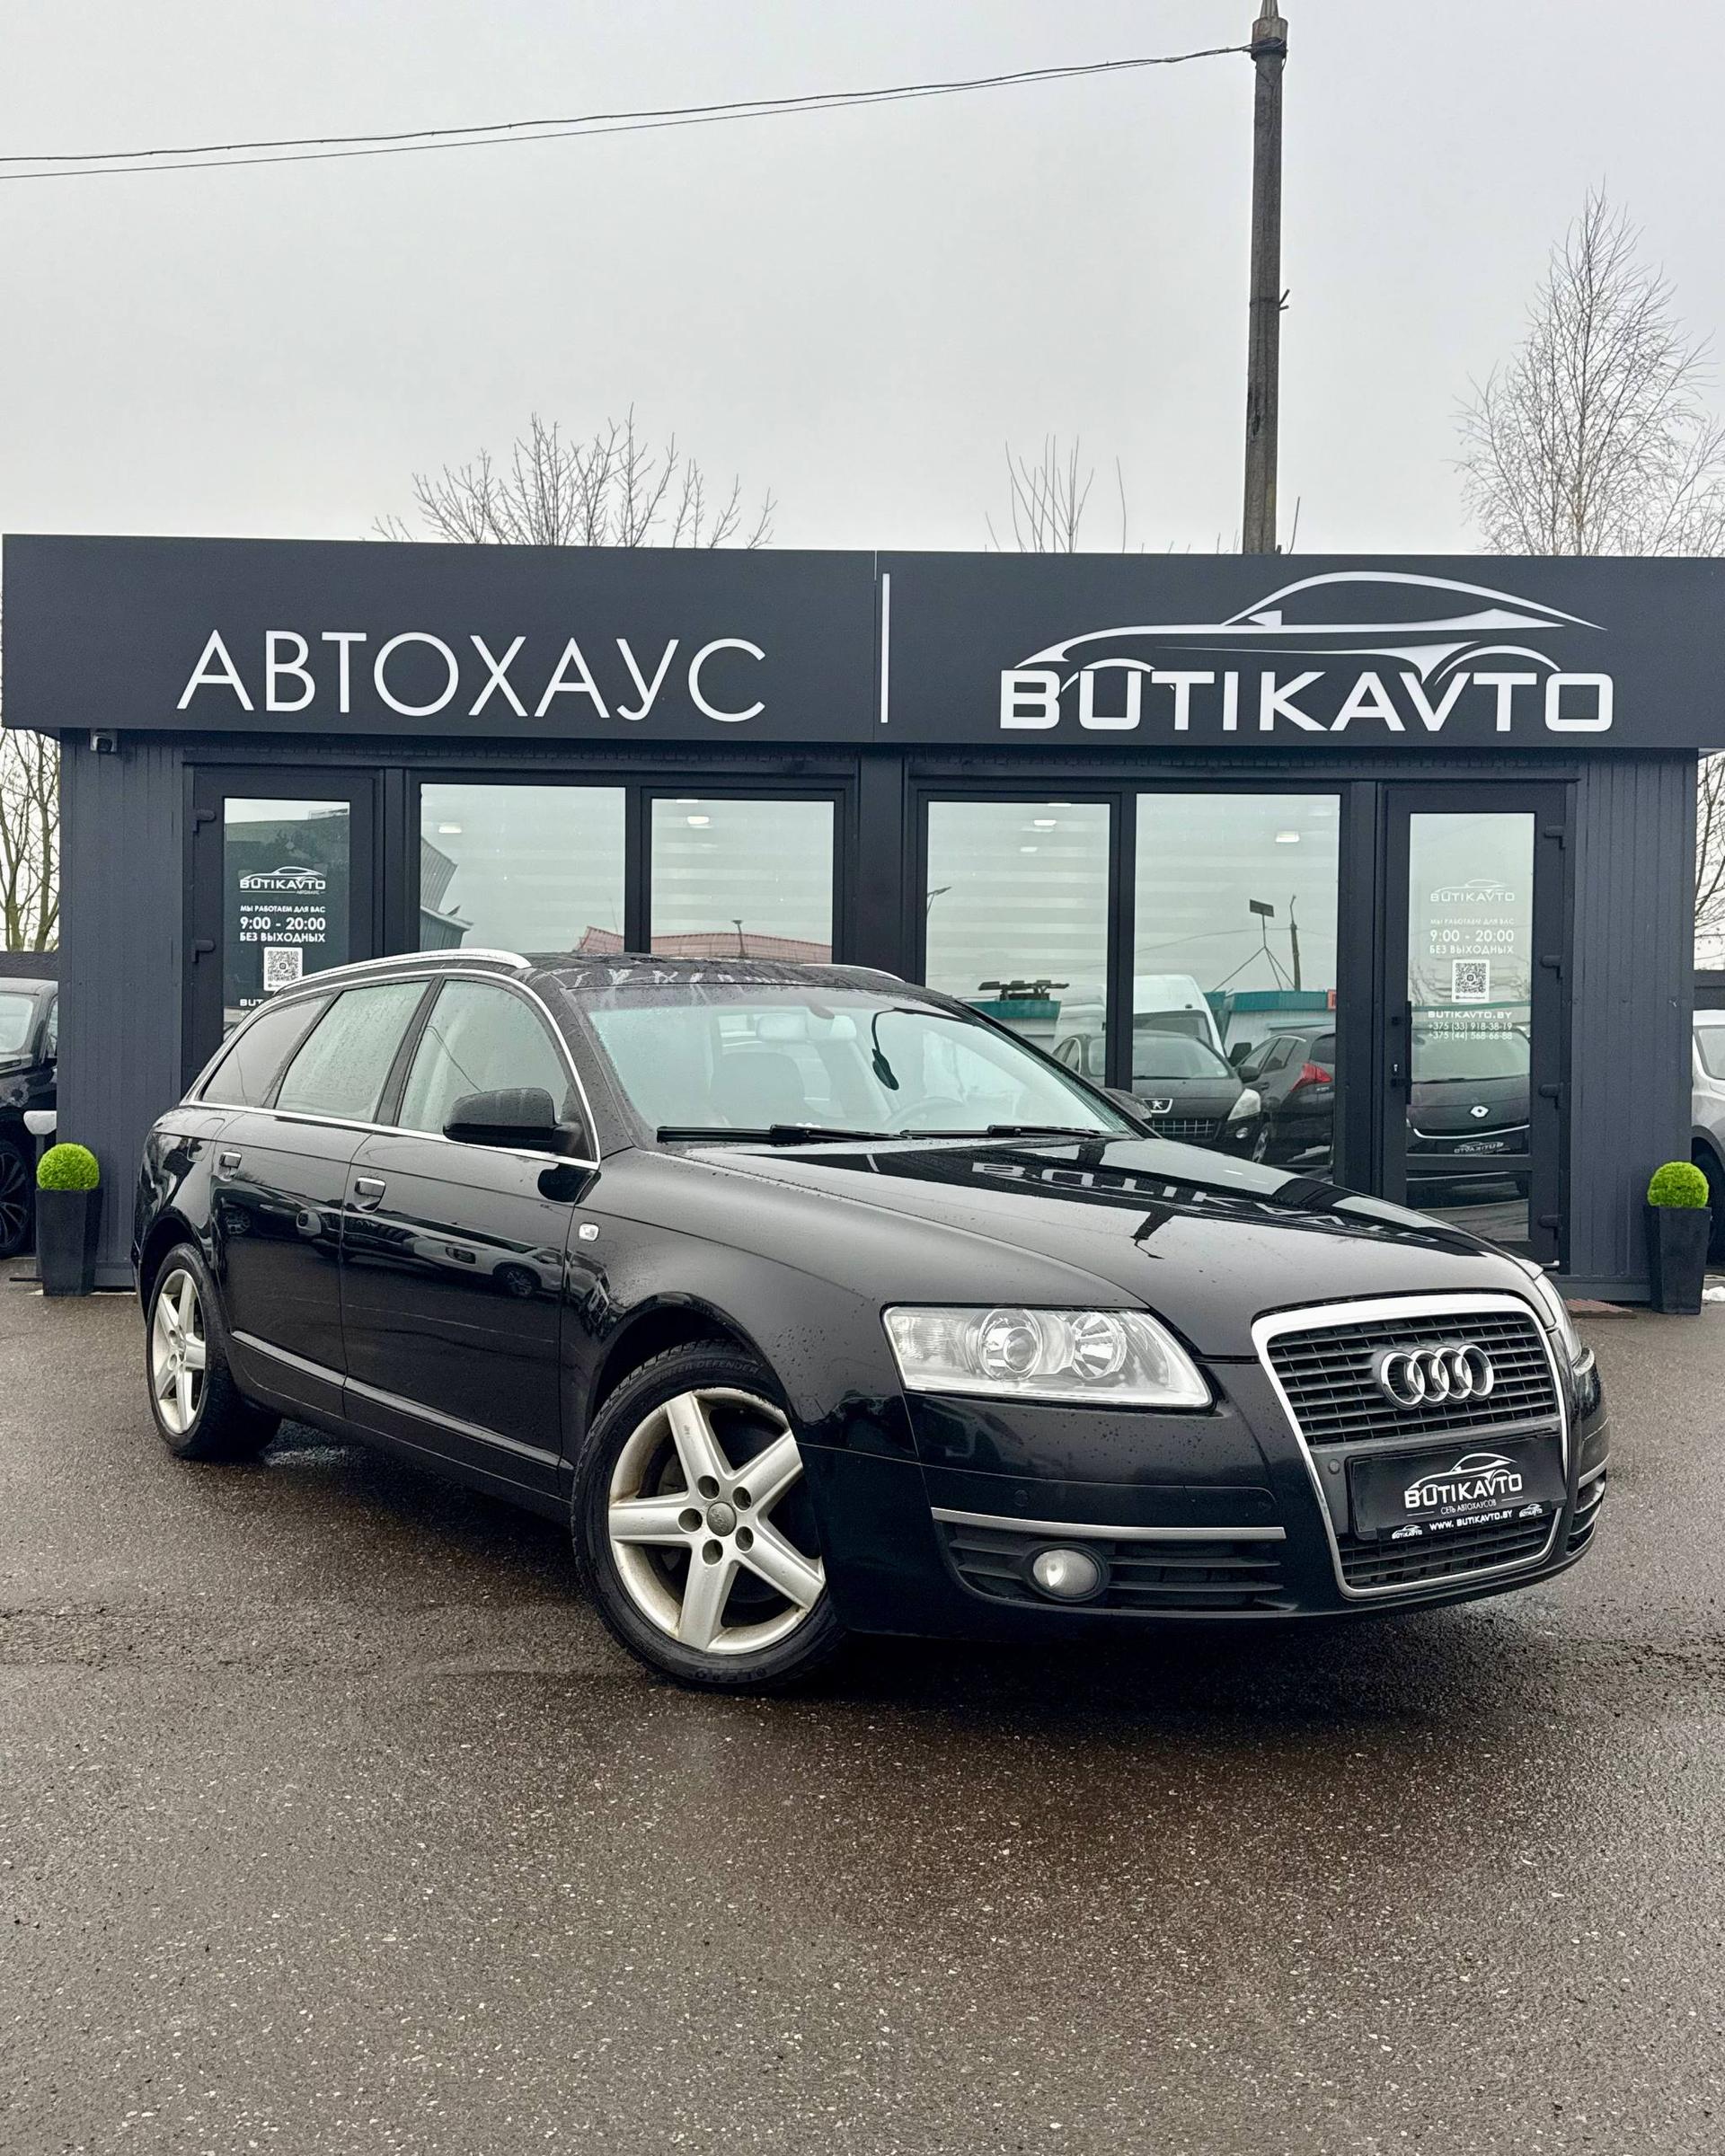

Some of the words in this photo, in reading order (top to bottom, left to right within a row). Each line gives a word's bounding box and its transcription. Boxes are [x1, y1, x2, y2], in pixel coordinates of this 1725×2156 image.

[177, 629, 765, 721] АВТОХАУС
[1000, 669, 1614, 732] BUTIKAVTO
[239, 879, 326, 889] BUTIKAVTO
[1430, 892, 1515, 902] BUTIKAVTO
[240, 905, 253, 913] МЫ
[254, 905, 293, 913] РАБОТАЕМ
[294, 906, 309, 914] ДЛЯ
[310, 906, 326, 914] ВАС
[240, 916, 271, 930] 9:00
[286, 917, 326, 931] 20:00
[239, 932, 258, 941] БЕЗ
[261, 932, 326, 943] ВЫХОДНЫХ
[1430, 929, 1460, 942] 9:00
[1475, 929, 1515, 942] 20:00
[1429, 944, 1446, 954] БЕЗ
[1449, 944, 1515, 955] ВЫХОДНЫХ
[1428, 1011, 1513, 1019] BUTIKAVTO.BY
[1428, 1021, 1449, 1030] +375
[1452, 1021, 1468, 1031] (33)
[1404, 1473, 1523, 1508] BUTIKAVTO
[1440, 1506, 1455, 1515] СЕТЬ
[1457, 1498, 1497, 1512] АВТОХАУСОВ
[1429, 1520, 1454, 1531] WWW.
[1456, 1509, 1513, 1527] BUTIKAVTO.BY
